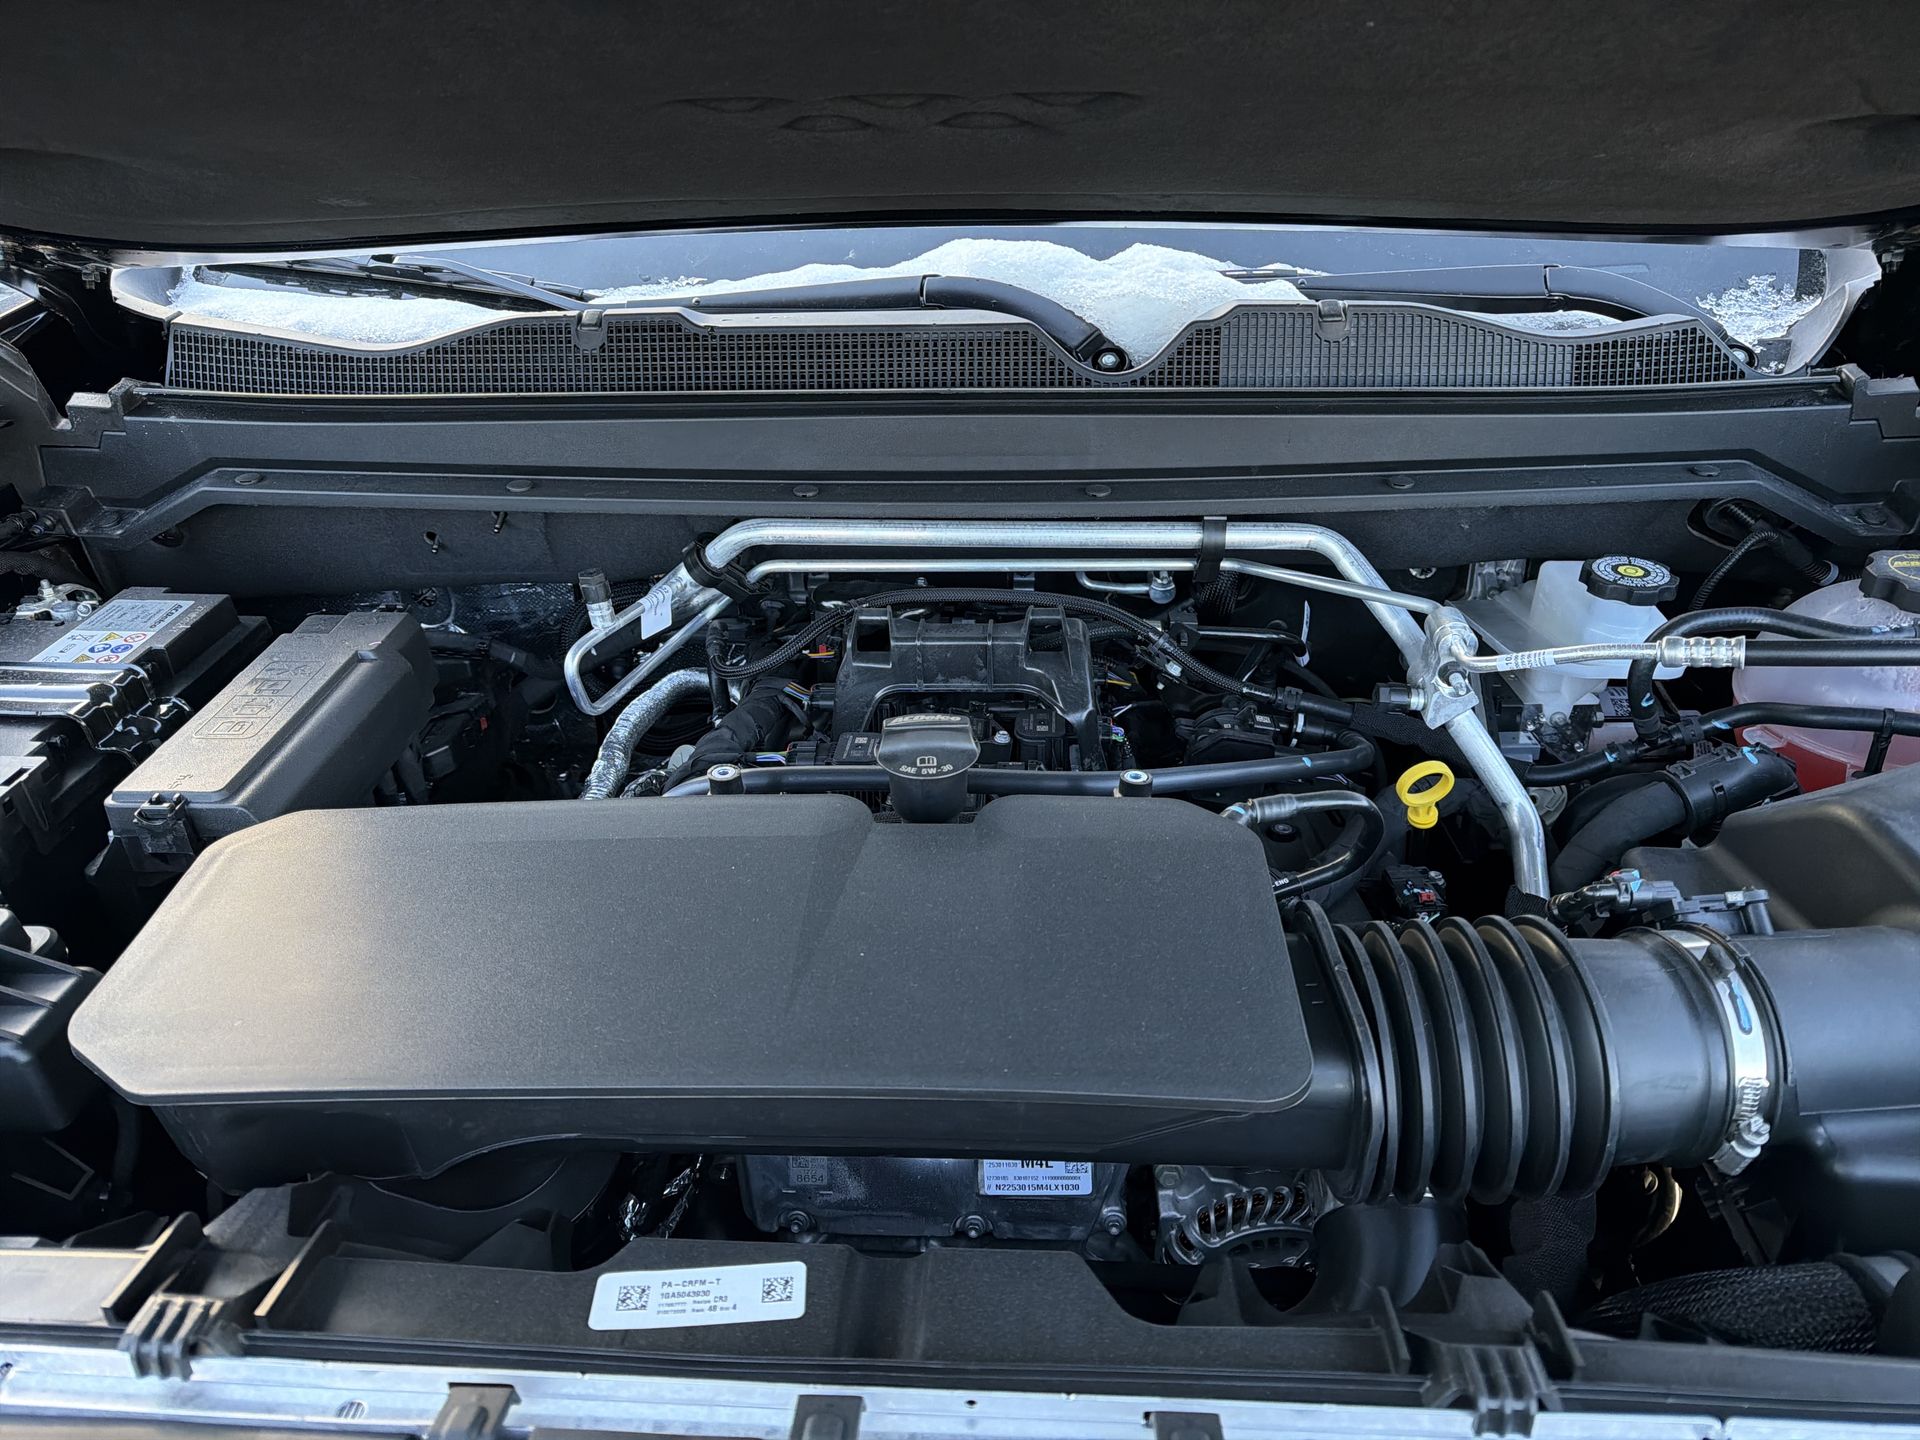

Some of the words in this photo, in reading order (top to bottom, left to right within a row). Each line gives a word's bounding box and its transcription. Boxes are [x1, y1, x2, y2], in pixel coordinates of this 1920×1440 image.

[887, 714, 961, 726] ACDelco
[899, 764, 918, 774] SAE
[921, 764, 954, 775] 5W-30
[1021, 1160, 1054, 1169] M4L
[796, 1174, 824, 1183] 8654
